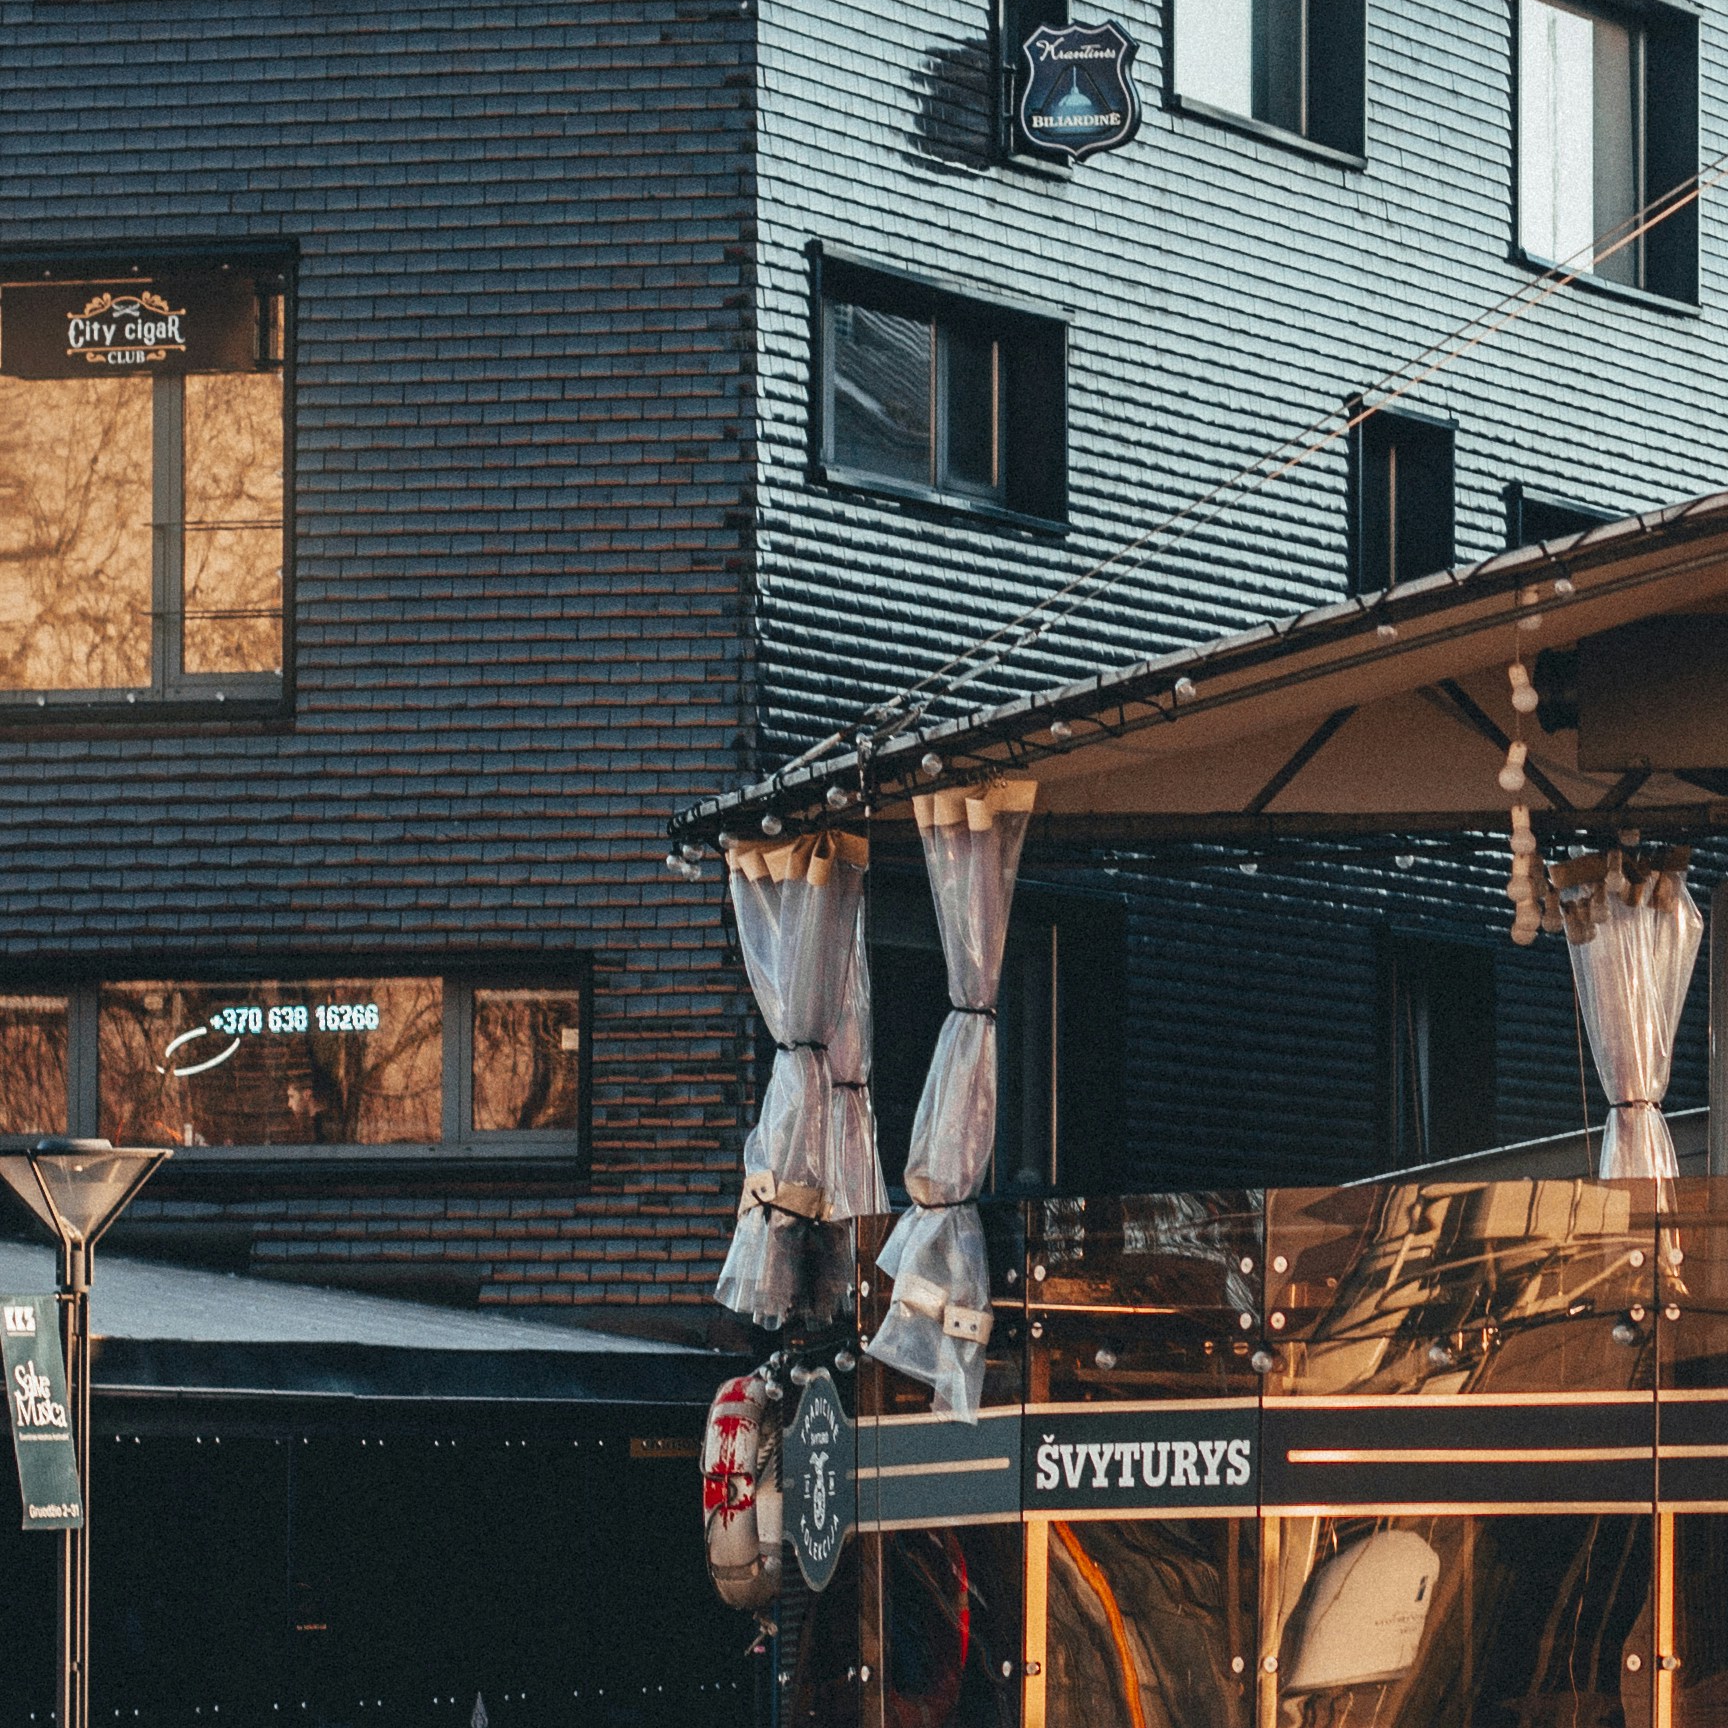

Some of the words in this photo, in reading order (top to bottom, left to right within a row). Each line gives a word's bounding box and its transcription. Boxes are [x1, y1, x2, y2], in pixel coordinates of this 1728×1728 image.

[68, 319, 116, 348] City
[108, 350, 145, 365] CLUB
[209, 1007, 263, 1034] +370
[268, 1006, 308, 1033] 638
[315, 1004, 379, 1031] 16266
[1036, 1434, 1251, 1490] ŠVYTURYS
